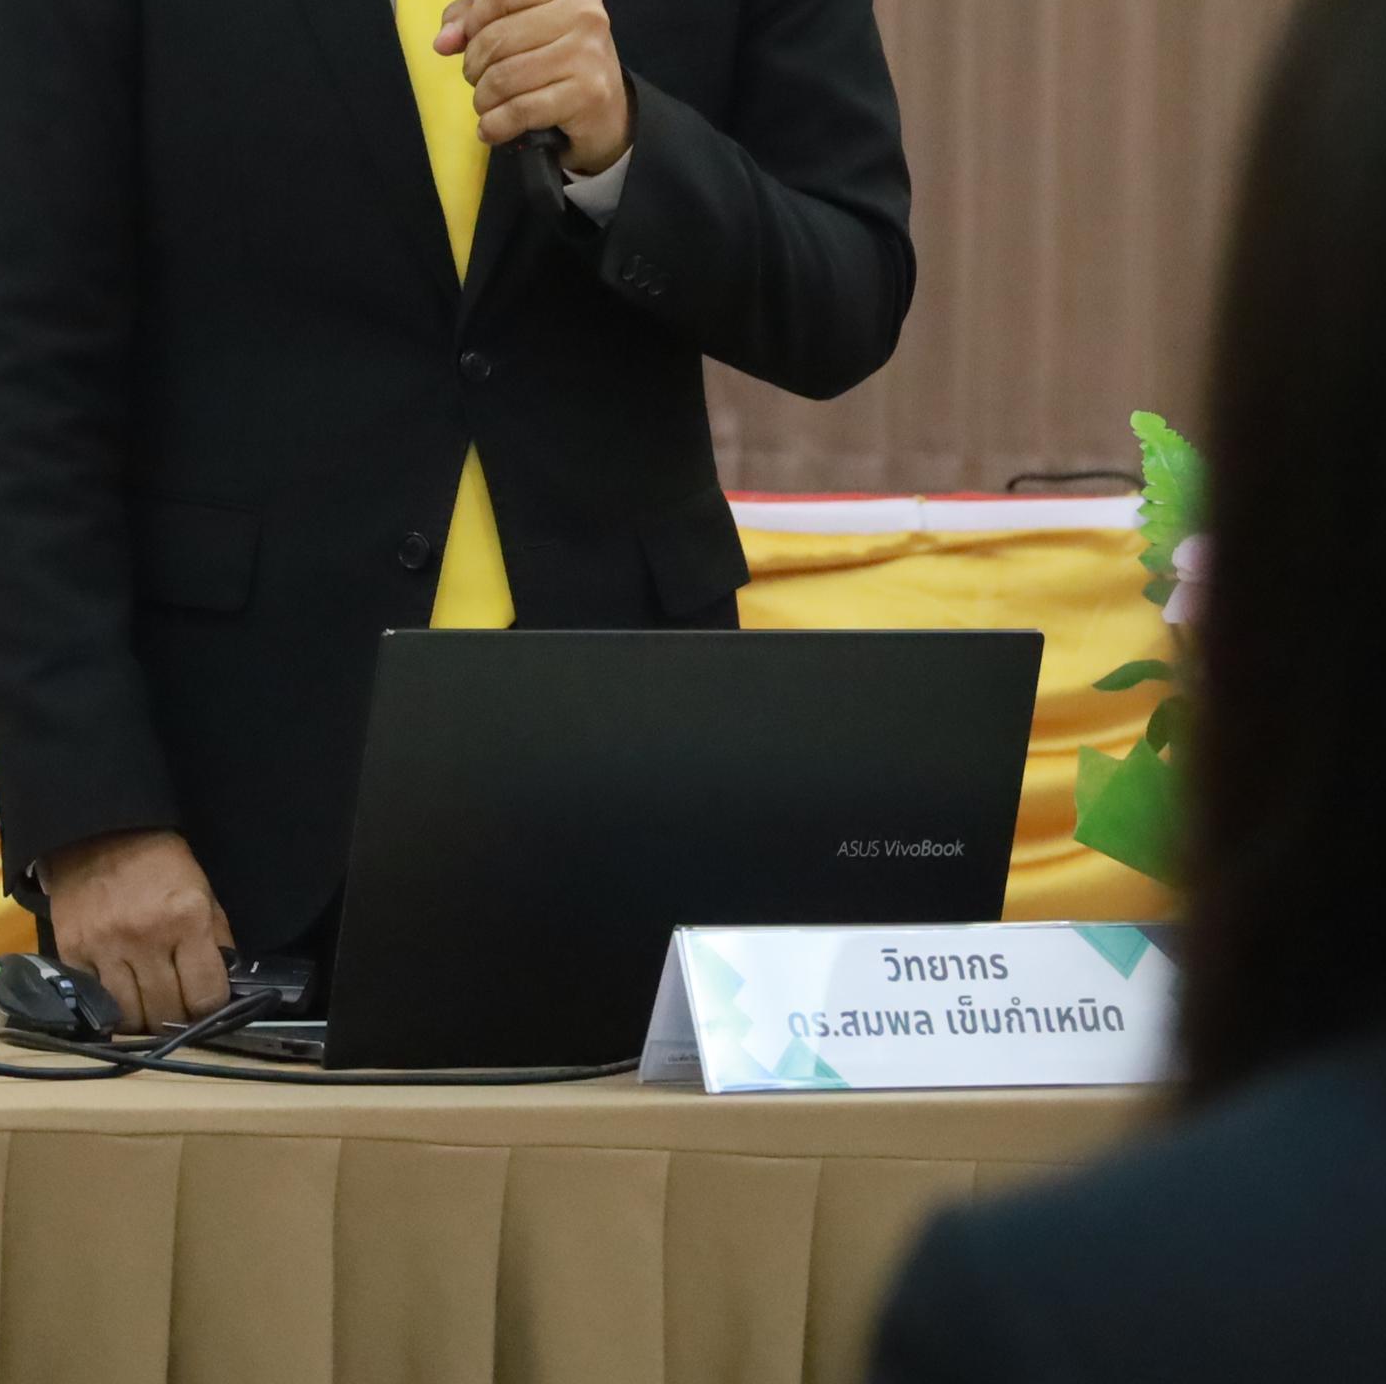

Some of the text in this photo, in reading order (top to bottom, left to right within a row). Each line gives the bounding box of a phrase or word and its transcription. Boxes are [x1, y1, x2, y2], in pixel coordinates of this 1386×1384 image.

[836, 838, 965, 857] ASUS VivoBook
[880, 948, 1009, 982] วิทยากร
[787, 995, 1125, 1038] ดร.สมพล เข็มกำเหนิด
